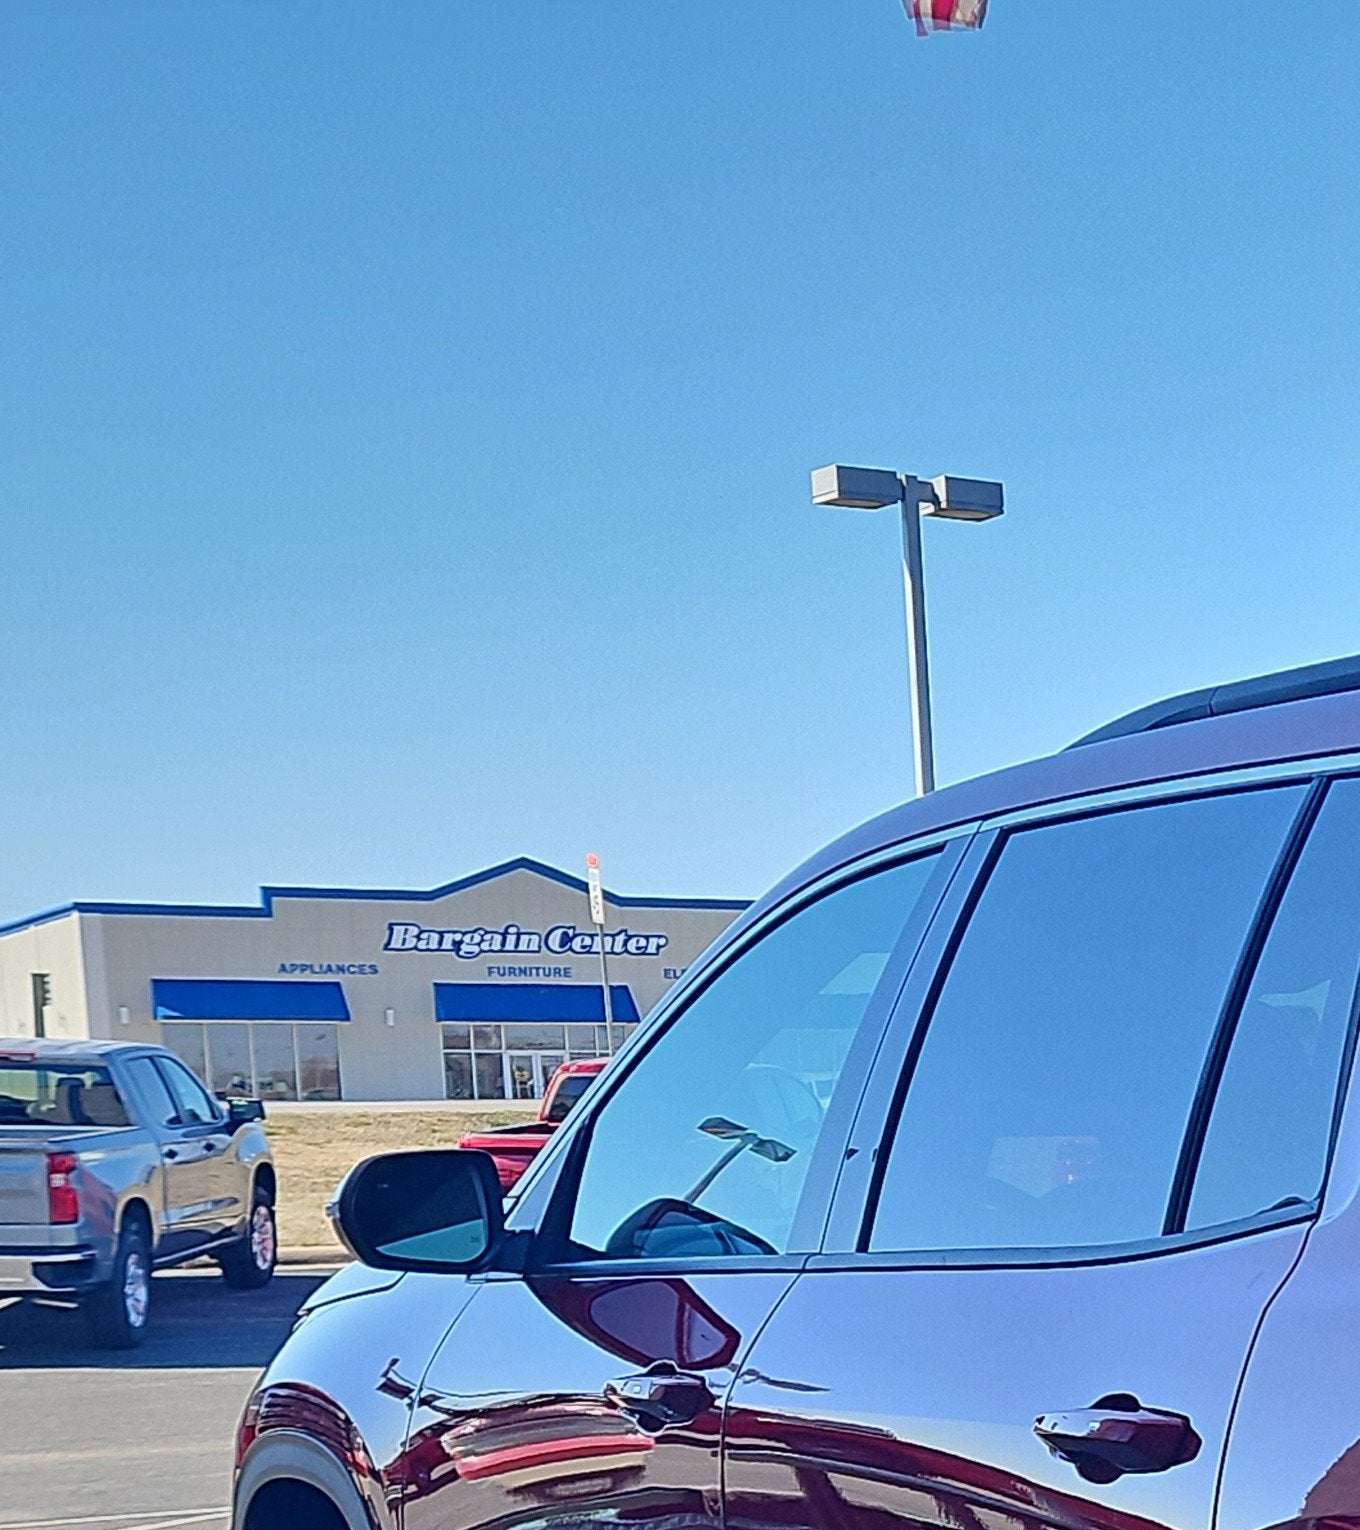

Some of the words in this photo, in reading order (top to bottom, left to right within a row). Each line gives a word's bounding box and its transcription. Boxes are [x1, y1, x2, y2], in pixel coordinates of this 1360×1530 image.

[384, 922, 542, 958] Bargain
[545, 926, 667, 955] Center
[278, 963, 379, 975] APPLIANCES
[487, 966, 572, 978] FURNITURE
